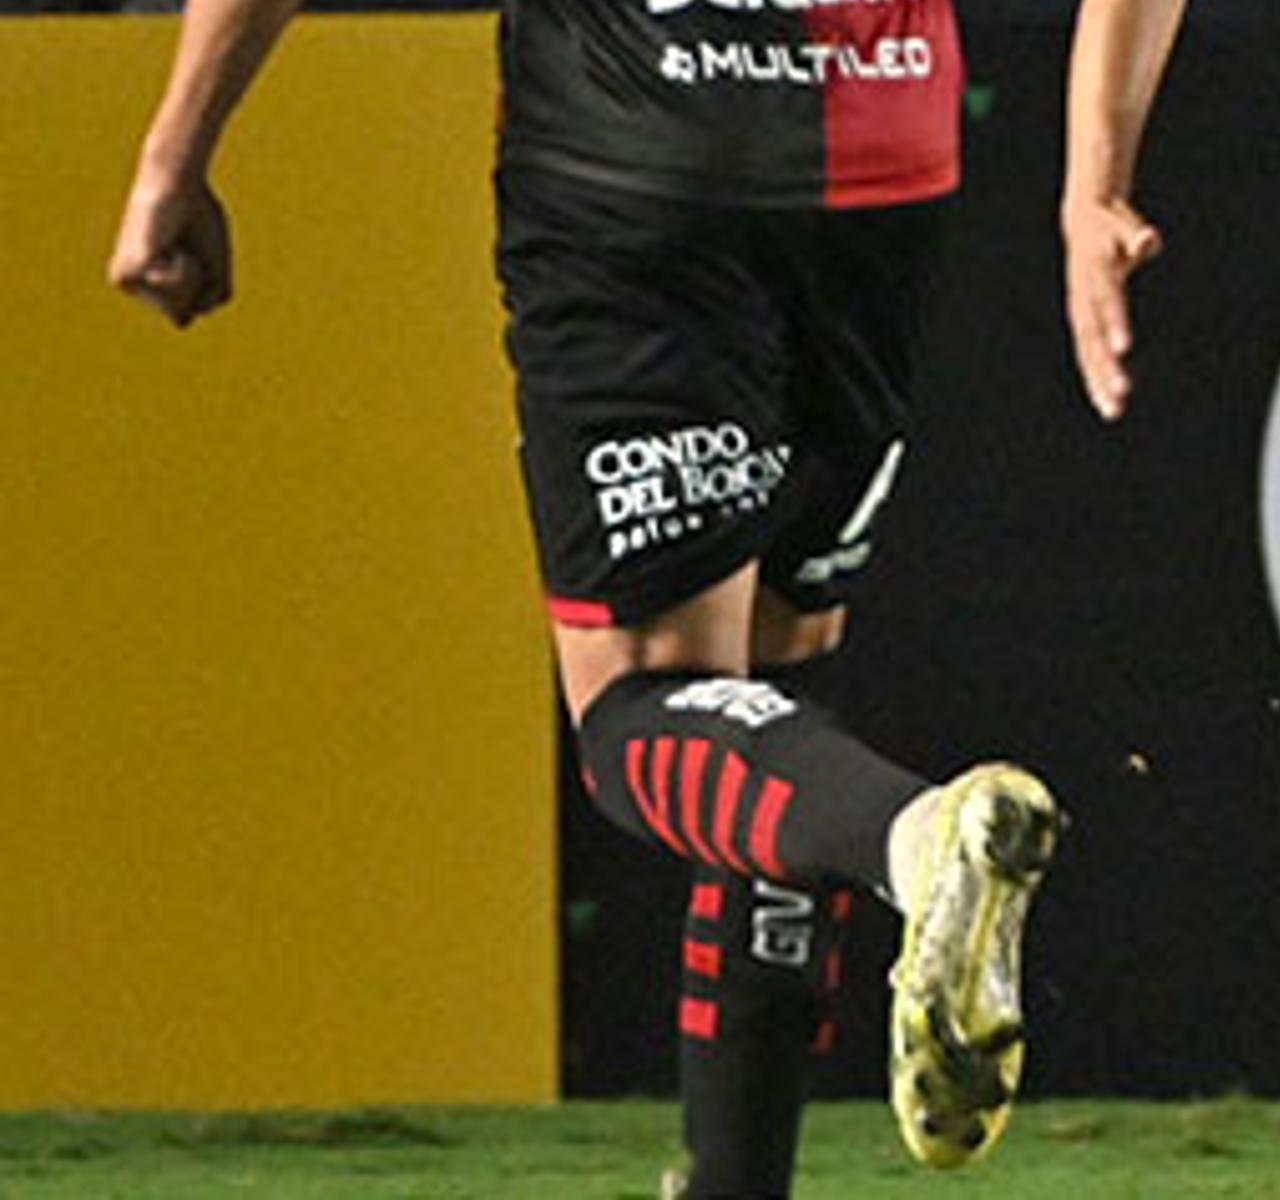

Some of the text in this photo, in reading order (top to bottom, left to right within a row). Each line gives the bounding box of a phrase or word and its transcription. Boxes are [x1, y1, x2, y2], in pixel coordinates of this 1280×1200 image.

[698, 39, 932, 83] MULTILED
[585, 422, 750, 484] CONDO
[597, 477, 678, 527] DEL
